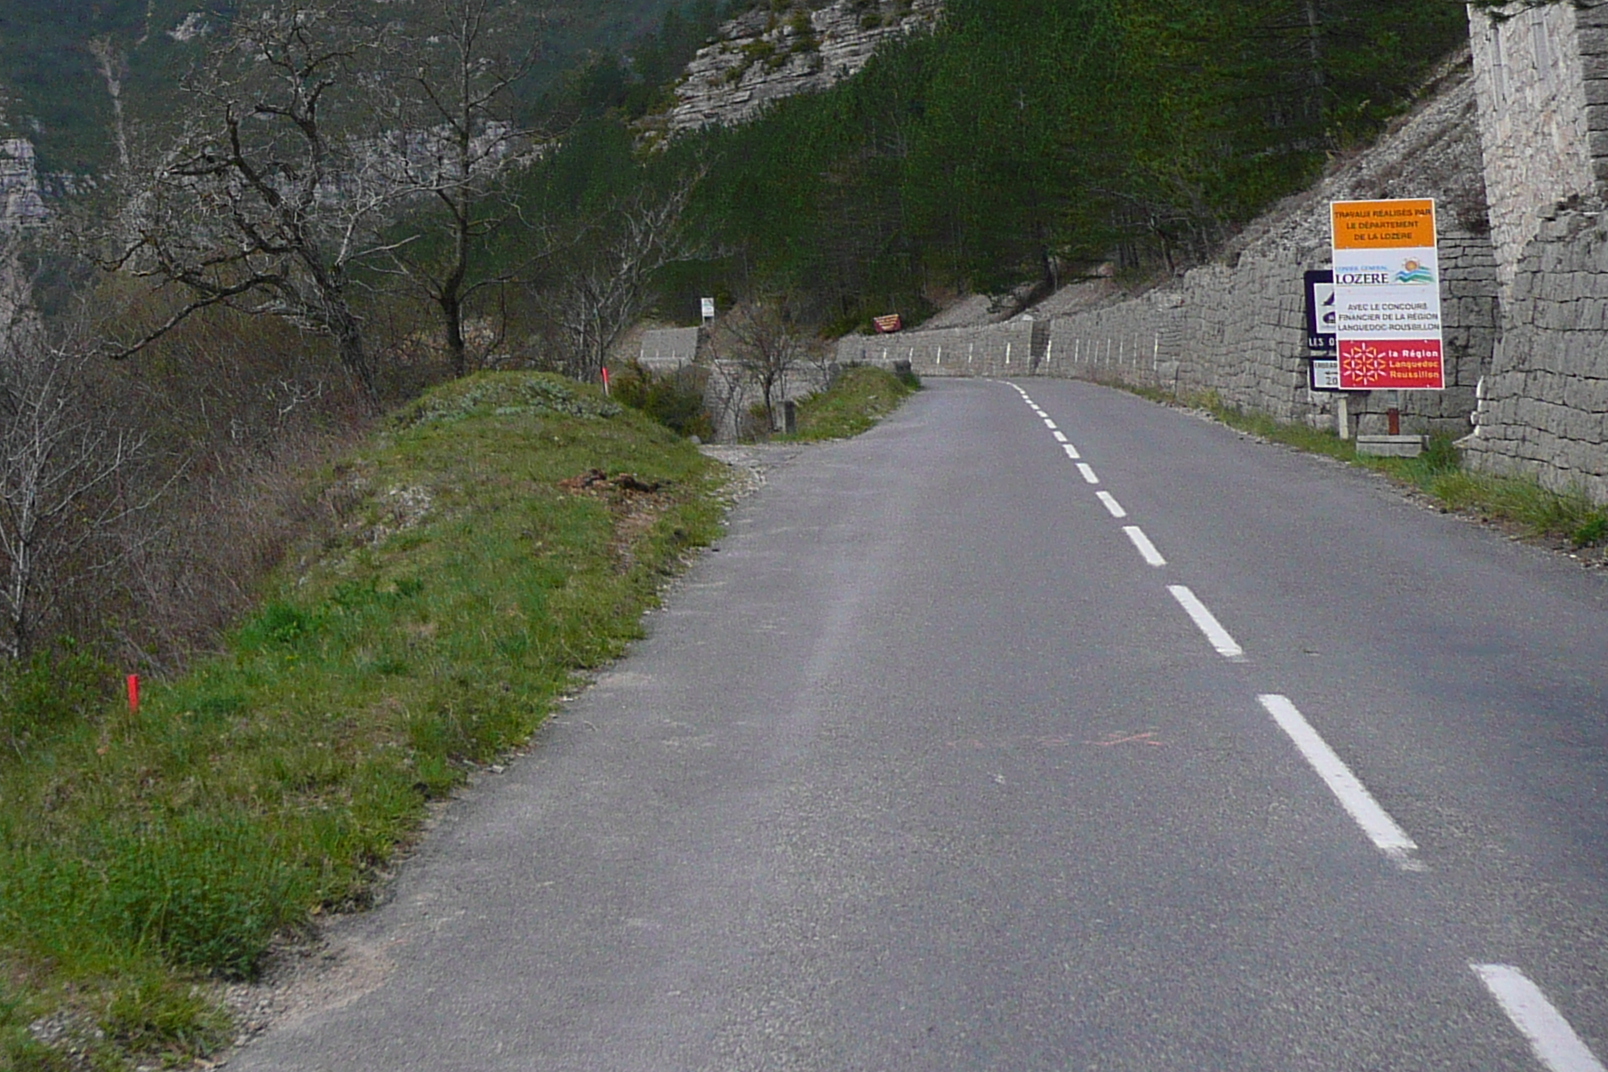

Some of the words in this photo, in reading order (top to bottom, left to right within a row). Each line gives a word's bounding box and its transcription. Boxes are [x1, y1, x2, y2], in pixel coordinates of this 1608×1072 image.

[1334, 211, 1371, 219] TRAVAUX
[1346, 222, 1356, 230] LE
[1335, 273, 1389, 284] LOZERE
[1347, 303, 1369, 311] AVEC
[1370, 303, 1379, 311] LE
[1381, 302, 1428, 310] CONCOURS
[1388, 349, 1399, 358] la
[1402, 349, 1438, 359] Région
[1389, 360, 1439, 369] Languedoc
[1390, 370, 1440, 379] Roussillon
